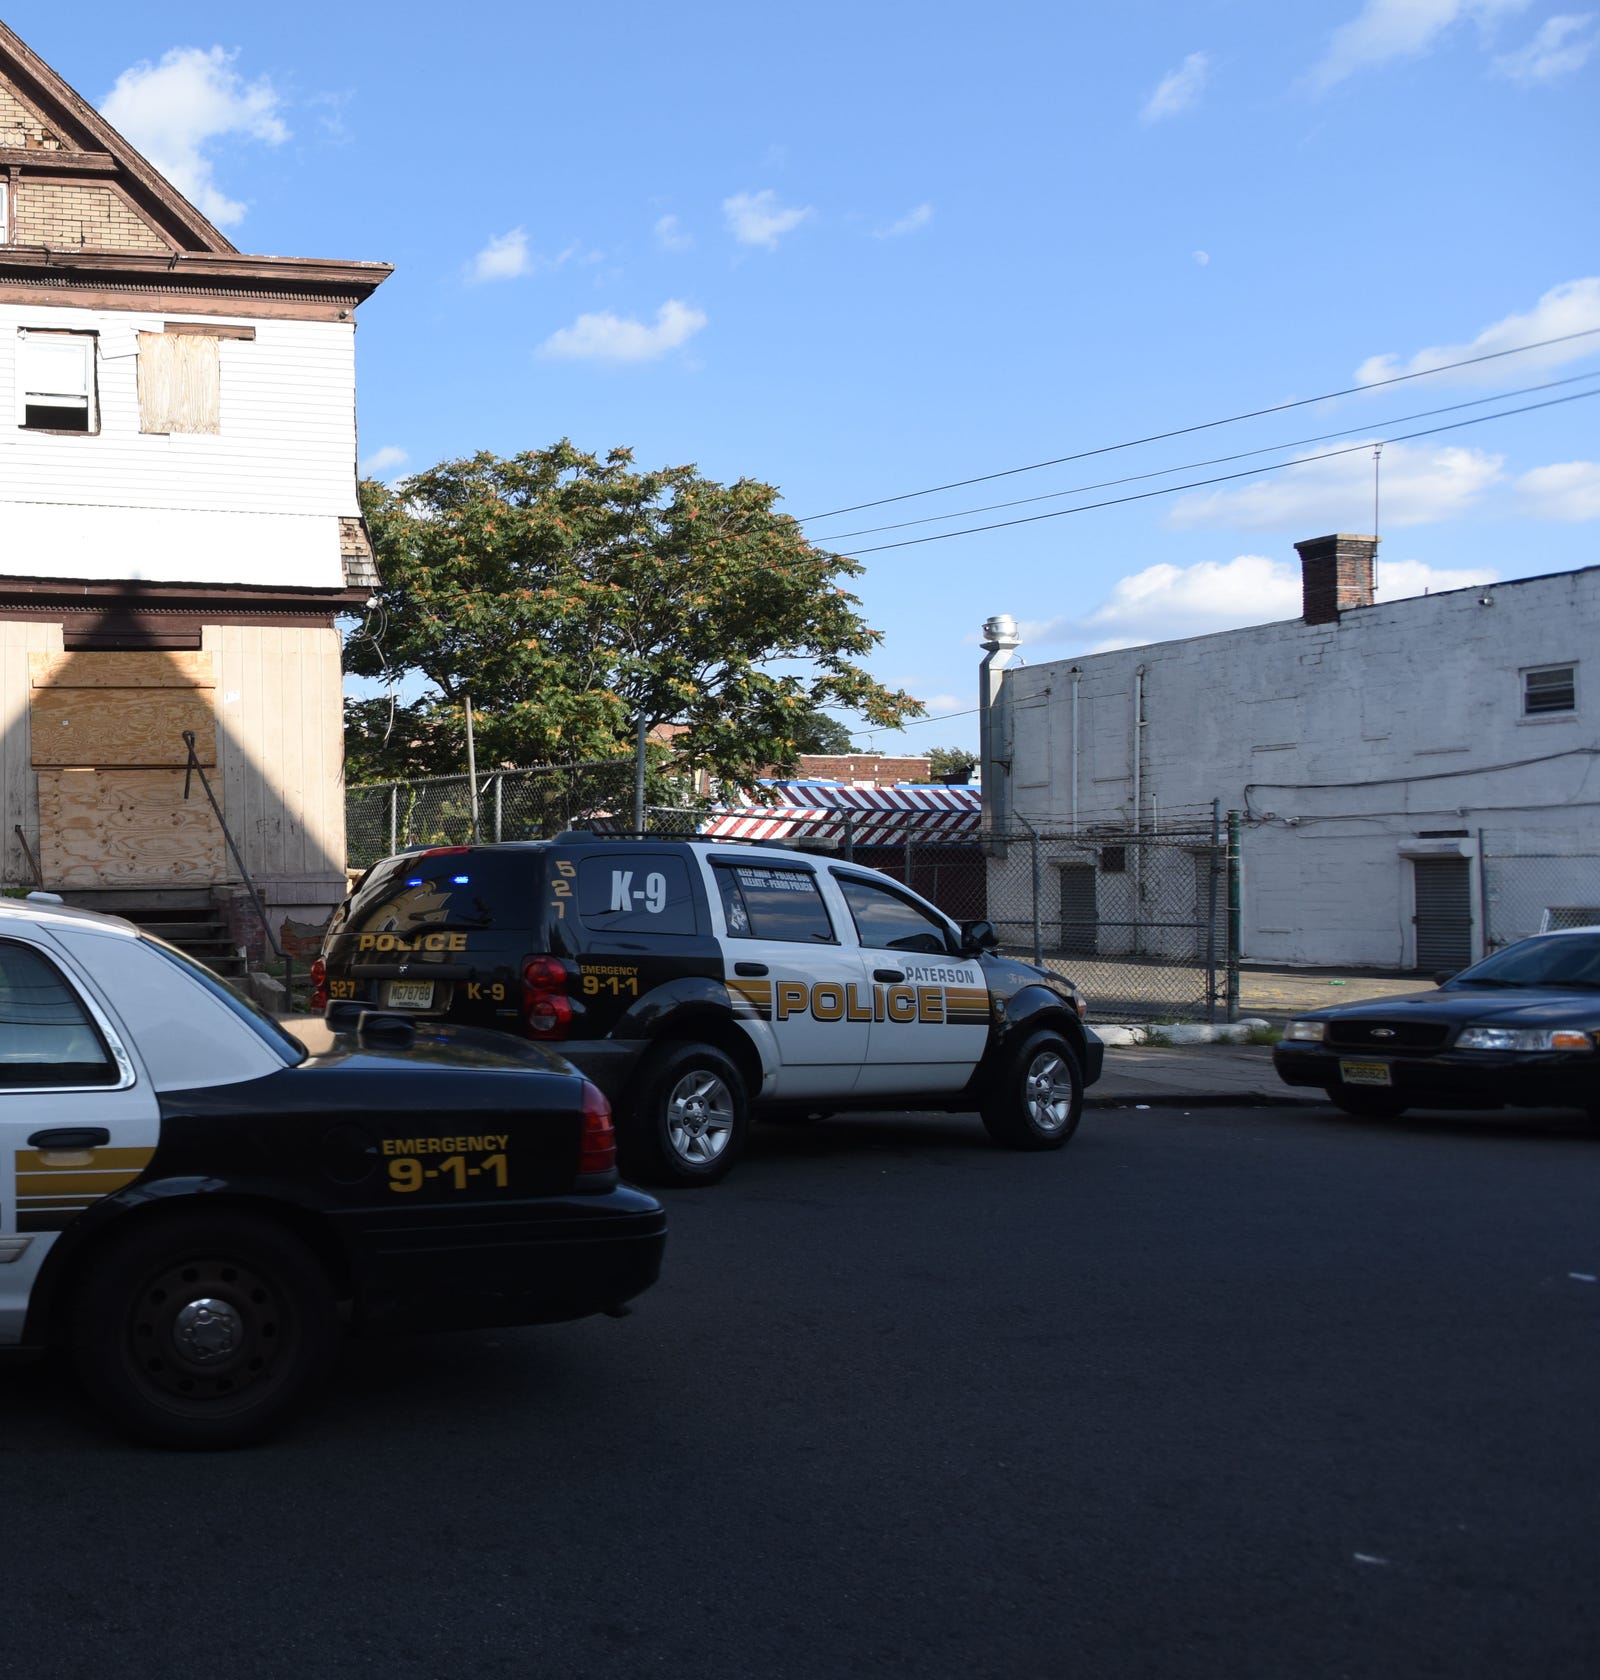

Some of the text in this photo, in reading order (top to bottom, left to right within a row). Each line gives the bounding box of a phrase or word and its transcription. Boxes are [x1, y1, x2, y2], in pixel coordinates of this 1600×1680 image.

[774, 871, 796, 880] POLICE
[551, 860, 576, 919] 527
[610, 870, 666, 913] K-9
[359, 934, 468, 951] POLICE
[581, 965, 638, 975] EMERGENCY
[905, 967, 974, 984] PATERSON
[330, 981, 355, 998] 527
[468, 983, 505, 1000] K-9
[583, 976, 638, 995] 9-1-1
[776, 981, 943, 1023] POLICE
[383, 1135, 508, 1155] EMERGENCY
[388, 1154, 508, 1192] 9-1-1
